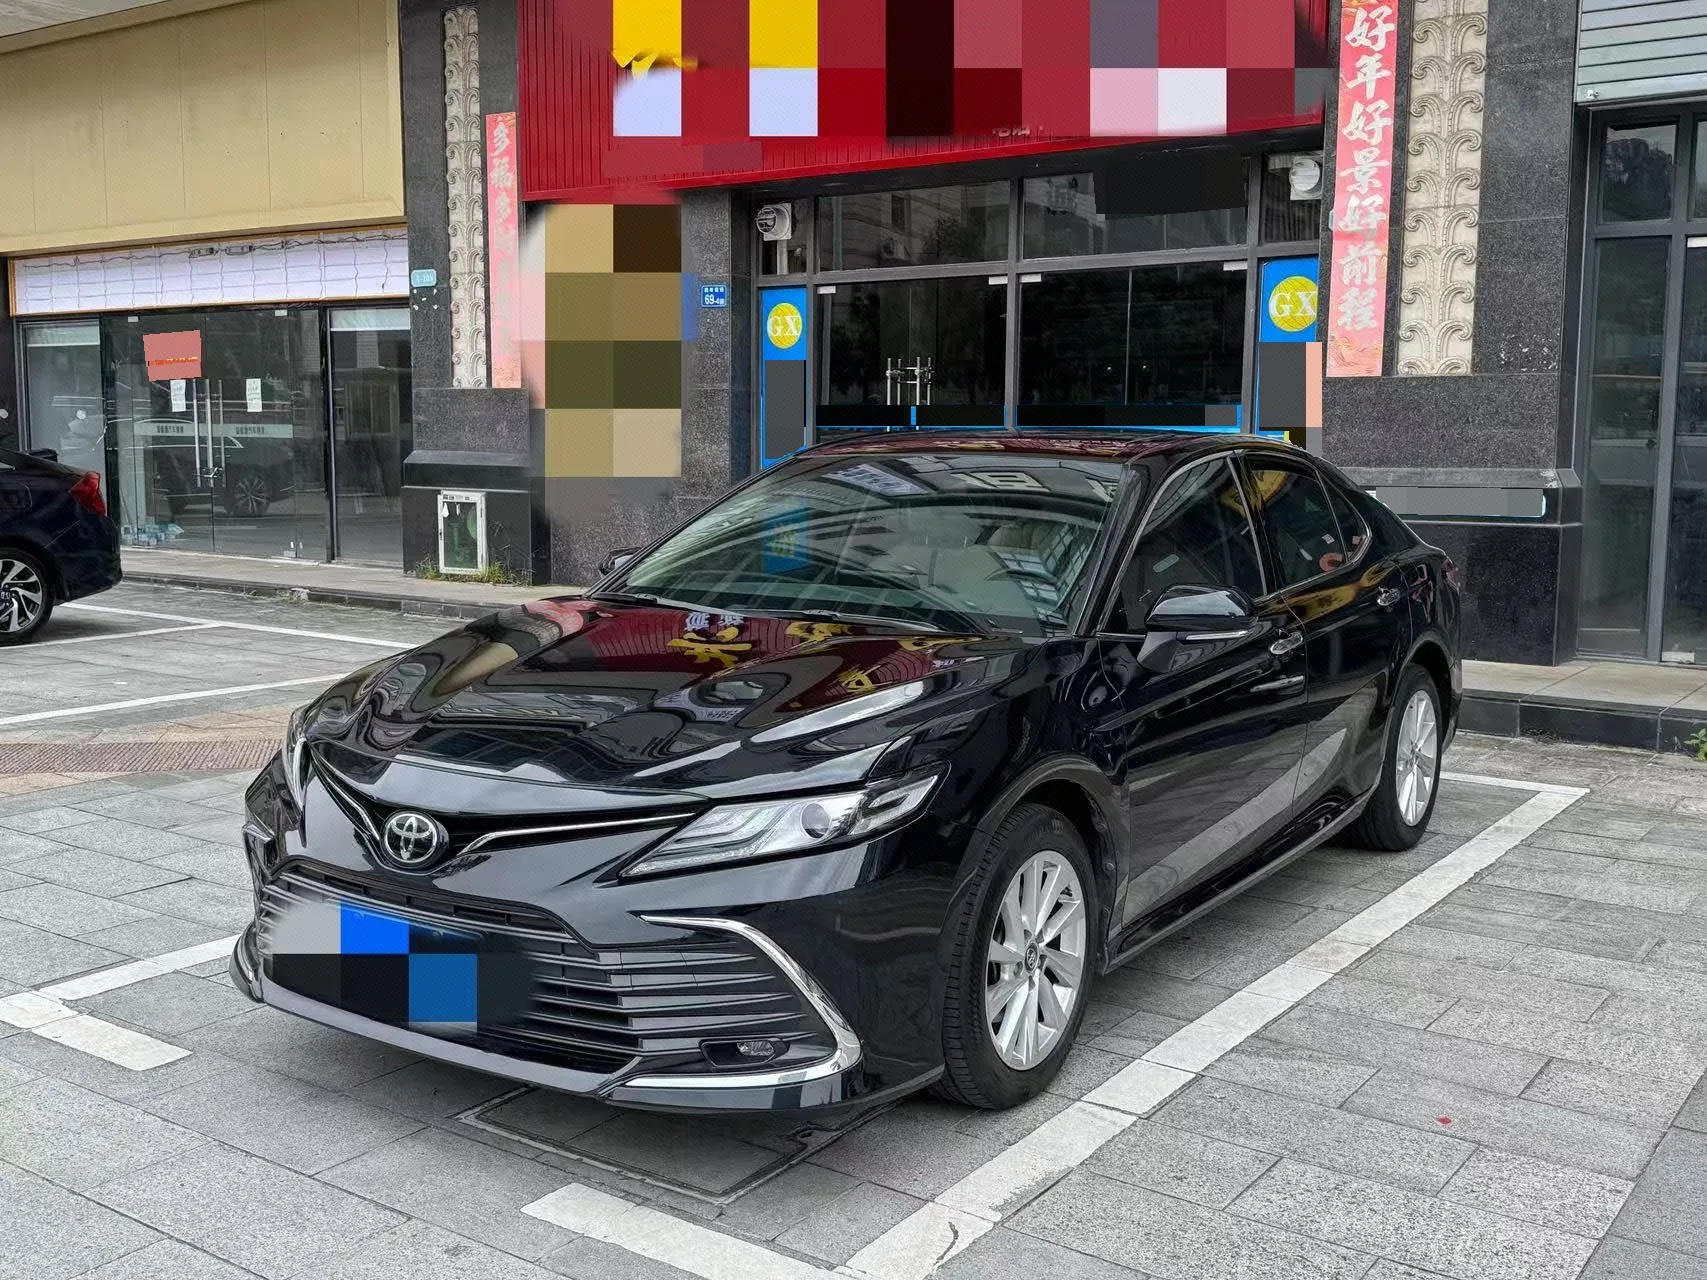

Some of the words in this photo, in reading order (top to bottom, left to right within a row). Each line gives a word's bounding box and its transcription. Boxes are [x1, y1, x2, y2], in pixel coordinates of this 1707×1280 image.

[1338, 5, 1395, 331] 好年好景好前程
[1269, 291, 1318, 317] GX
[767, 315, 801, 336] GX
